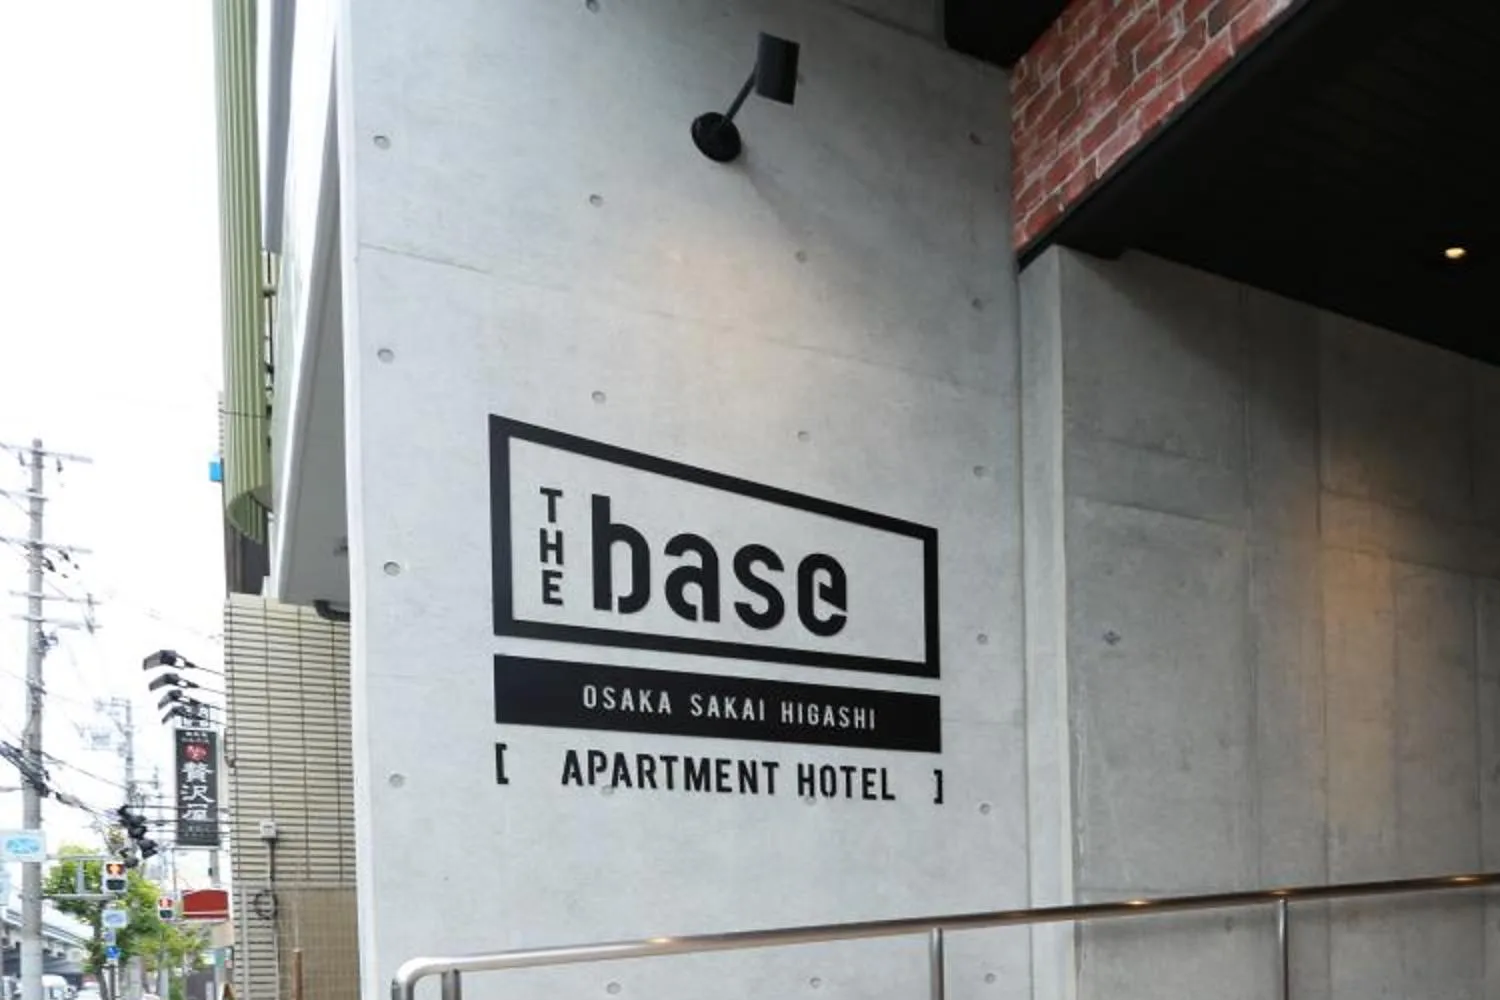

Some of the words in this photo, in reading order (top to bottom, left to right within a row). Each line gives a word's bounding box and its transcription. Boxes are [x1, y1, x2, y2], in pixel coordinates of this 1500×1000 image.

[539, 487, 564, 606] THE
[591, 494, 847, 637] base
[582, 685, 673, 715] OSAKA
[690, 694, 766, 722] SAKAI
[780, 703, 876, 729] HIGASHI
[561, 750, 780, 795] APARTMENT
[796, 763, 896, 801] HOTEL
